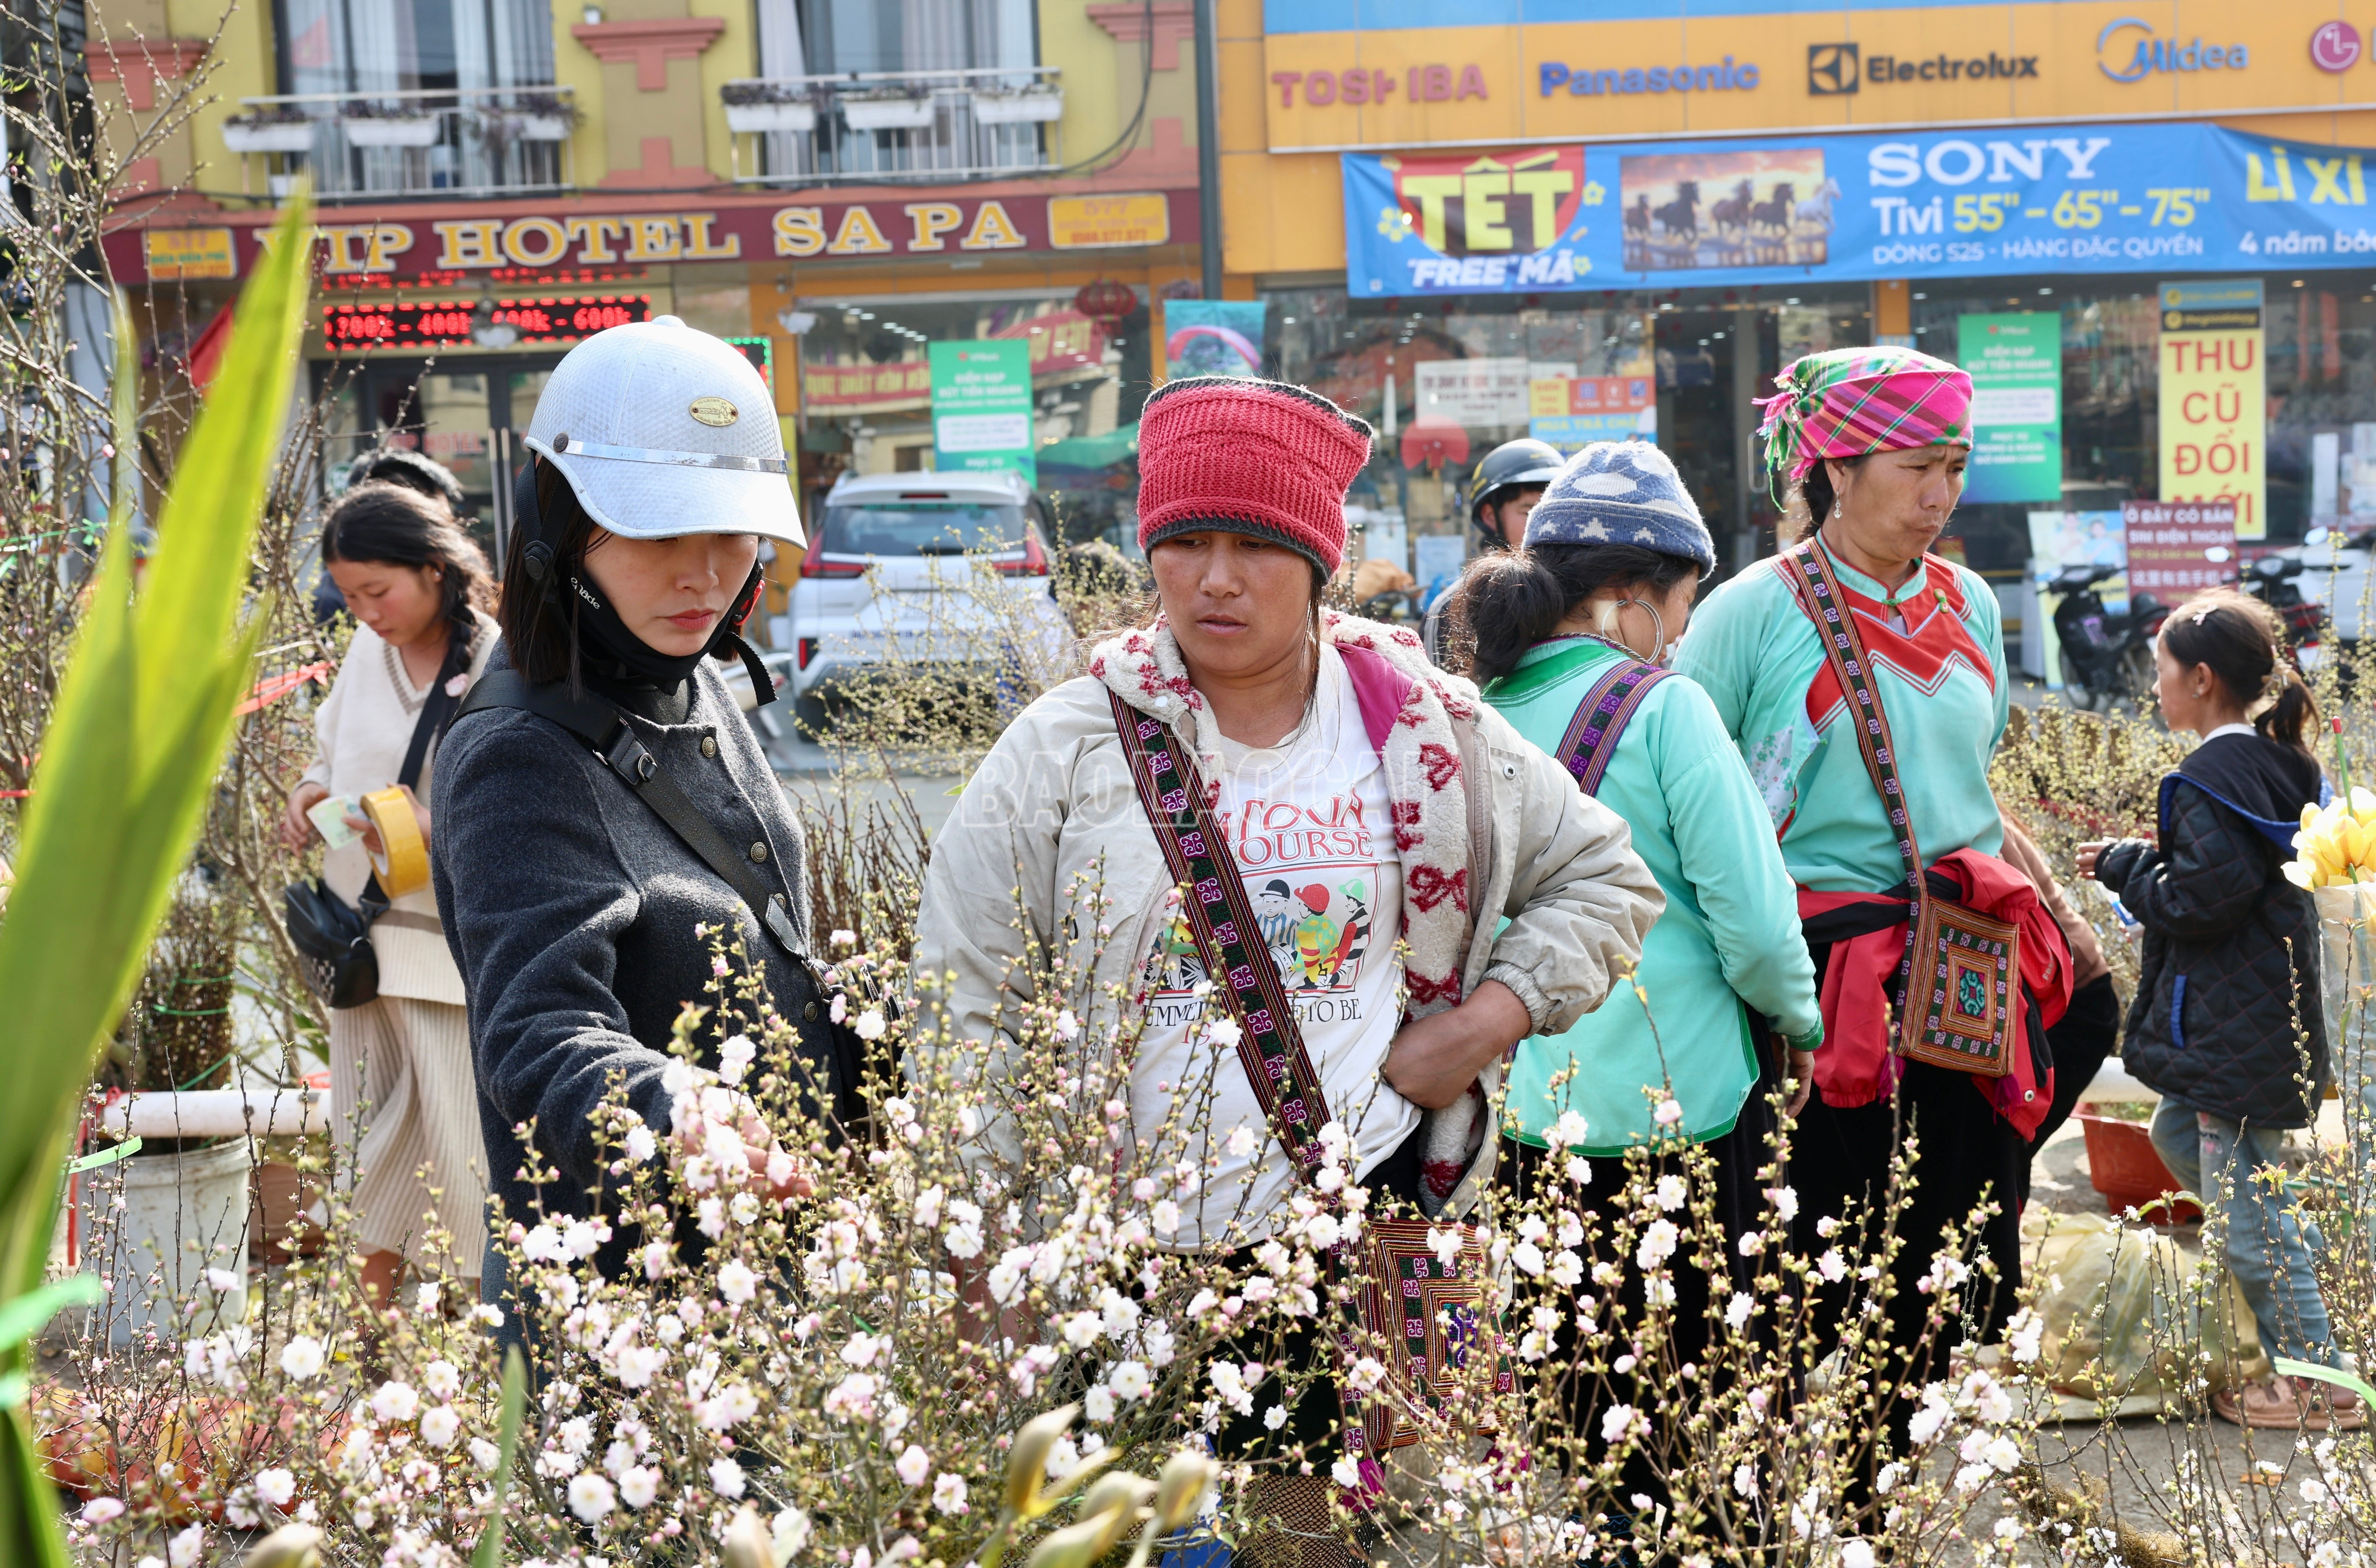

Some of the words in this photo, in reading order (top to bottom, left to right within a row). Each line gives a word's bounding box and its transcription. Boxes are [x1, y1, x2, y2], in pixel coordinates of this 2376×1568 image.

[1539, 55, 1759, 97] Panasonic
[1868, 52, 2039, 83] Electrolux
[2120, 36, 2249, 76] Midea
[1867, 137, 2112, 187] SONY
[1402, 151, 1574, 252] TẾT
[1870, 196, 1943, 236] Tivi
[433, 212, 741, 269] HOTEL
[772, 206, 892, 257] SA
[904, 200, 1027, 252] PA
[1872, 241, 1942, 265] DÒNG
[1945, 242, 1984, 261] S25
[2003, 235, 2068, 259] HÀNG
[2238, 230, 2259, 255] 4
[2265, 229, 2328, 254] năm
[1516, 249, 1575, 284] MÃ
[2166, 338, 2254, 373] THU
[2182, 383, 2241, 424] CŨ
[2172, 428, 2249, 475] ĐỔI
[2174, 483, 2252, 524] ỚI
[1236, 830, 1374, 867] OURSE
[1308, 1000, 1334, 1022] TO
[1339, 998, 1362, 1021] BE
